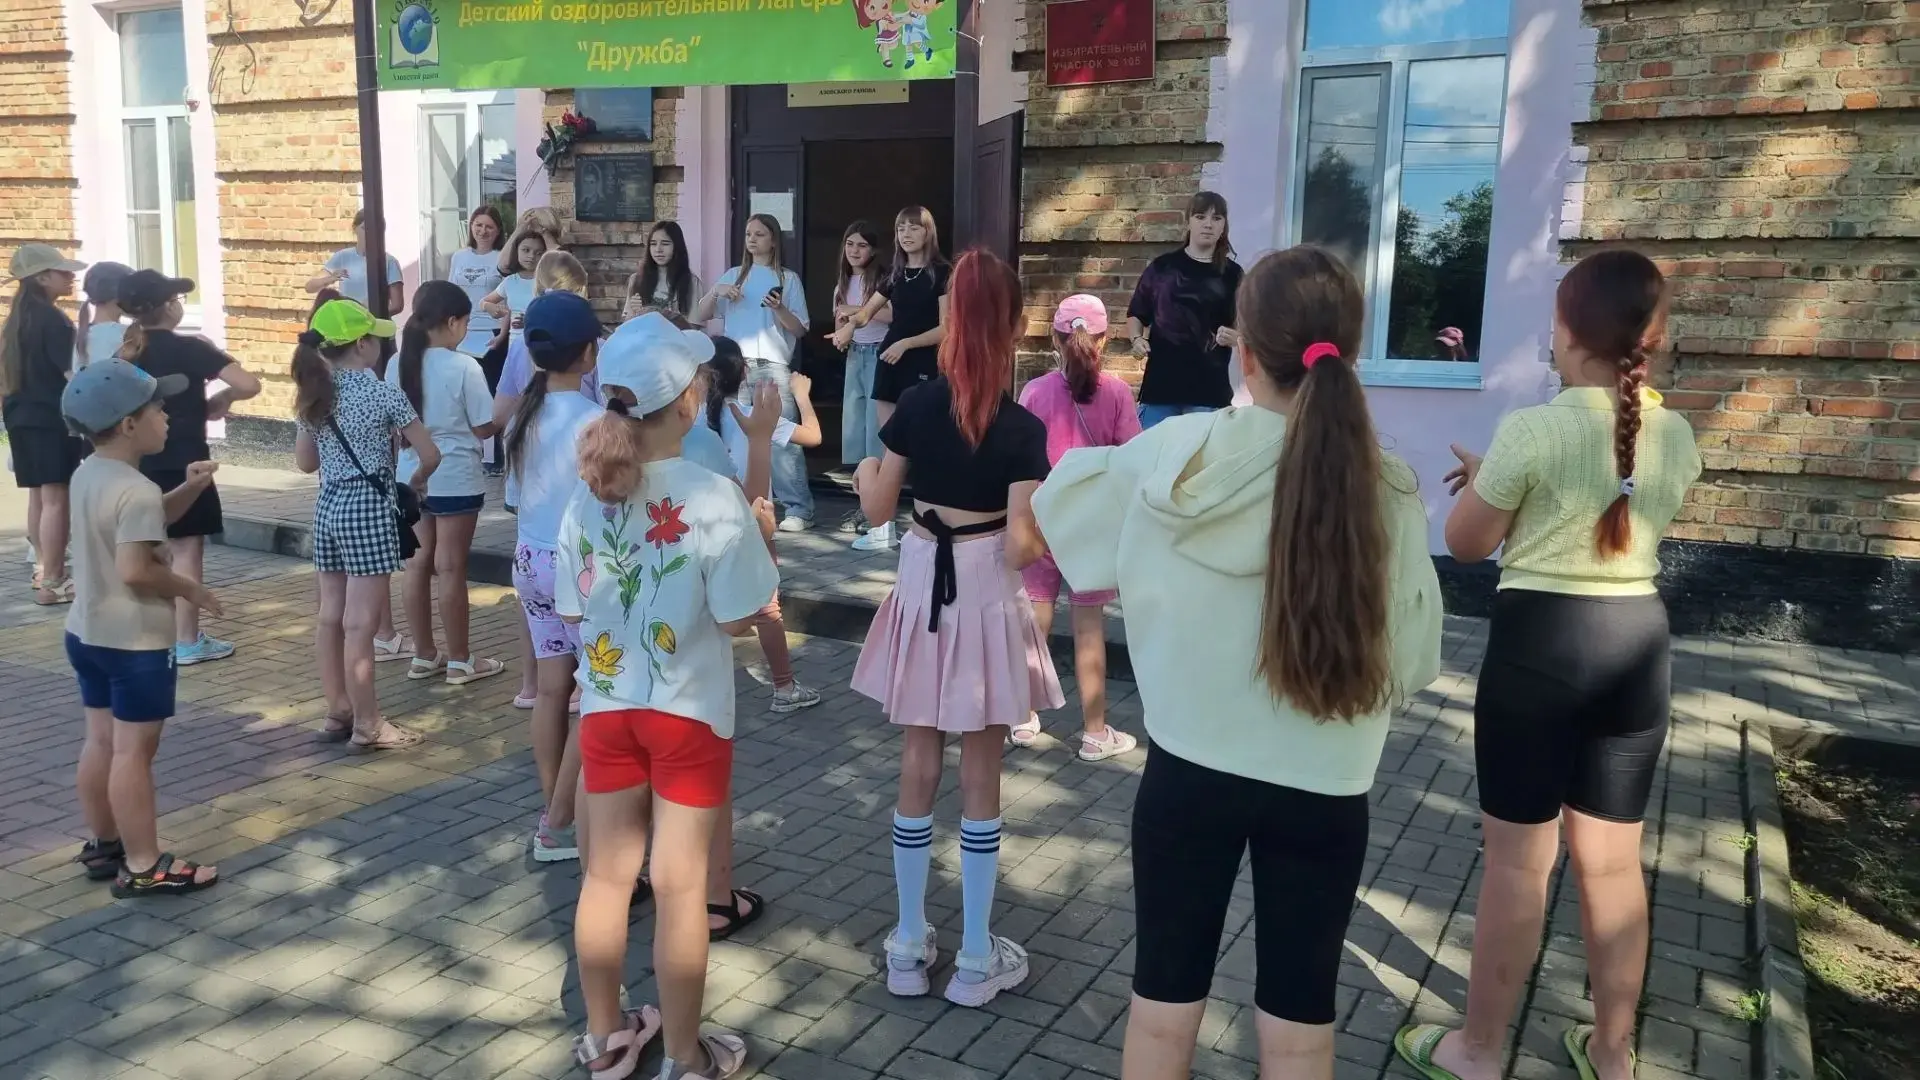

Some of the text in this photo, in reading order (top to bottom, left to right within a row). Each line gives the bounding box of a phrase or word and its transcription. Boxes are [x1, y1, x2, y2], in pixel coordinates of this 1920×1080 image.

[458, 0, 543, 27] Детский
[1052, 40, 1147, 58] ИЗБИРАТЕЛЬНЫЙ
[1053, 59, 1103, 71] УЧАСТОК
